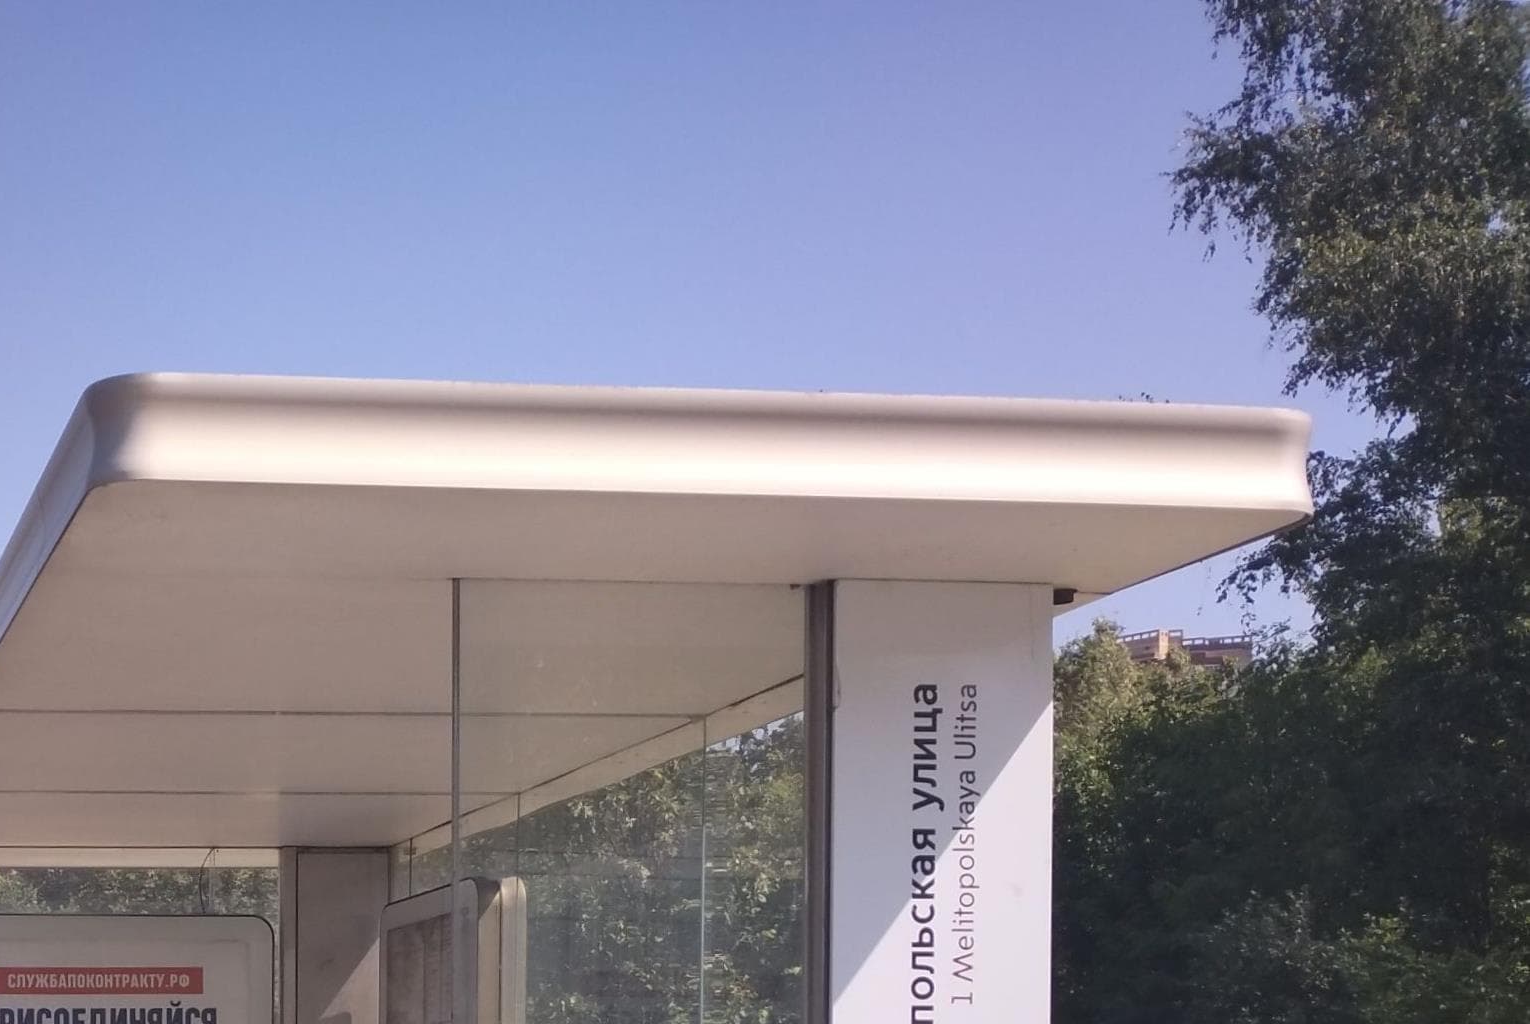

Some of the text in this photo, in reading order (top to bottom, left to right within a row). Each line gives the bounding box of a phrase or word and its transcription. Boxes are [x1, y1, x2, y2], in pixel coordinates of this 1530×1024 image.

[912, 683, 945, 813] улица
[951, 684, 981, 1004] 1 Melitopolskaya Ulitsa
[7, 973, 190, 989] СЛУЖБАПОКОНТРАКТУ.РФ
